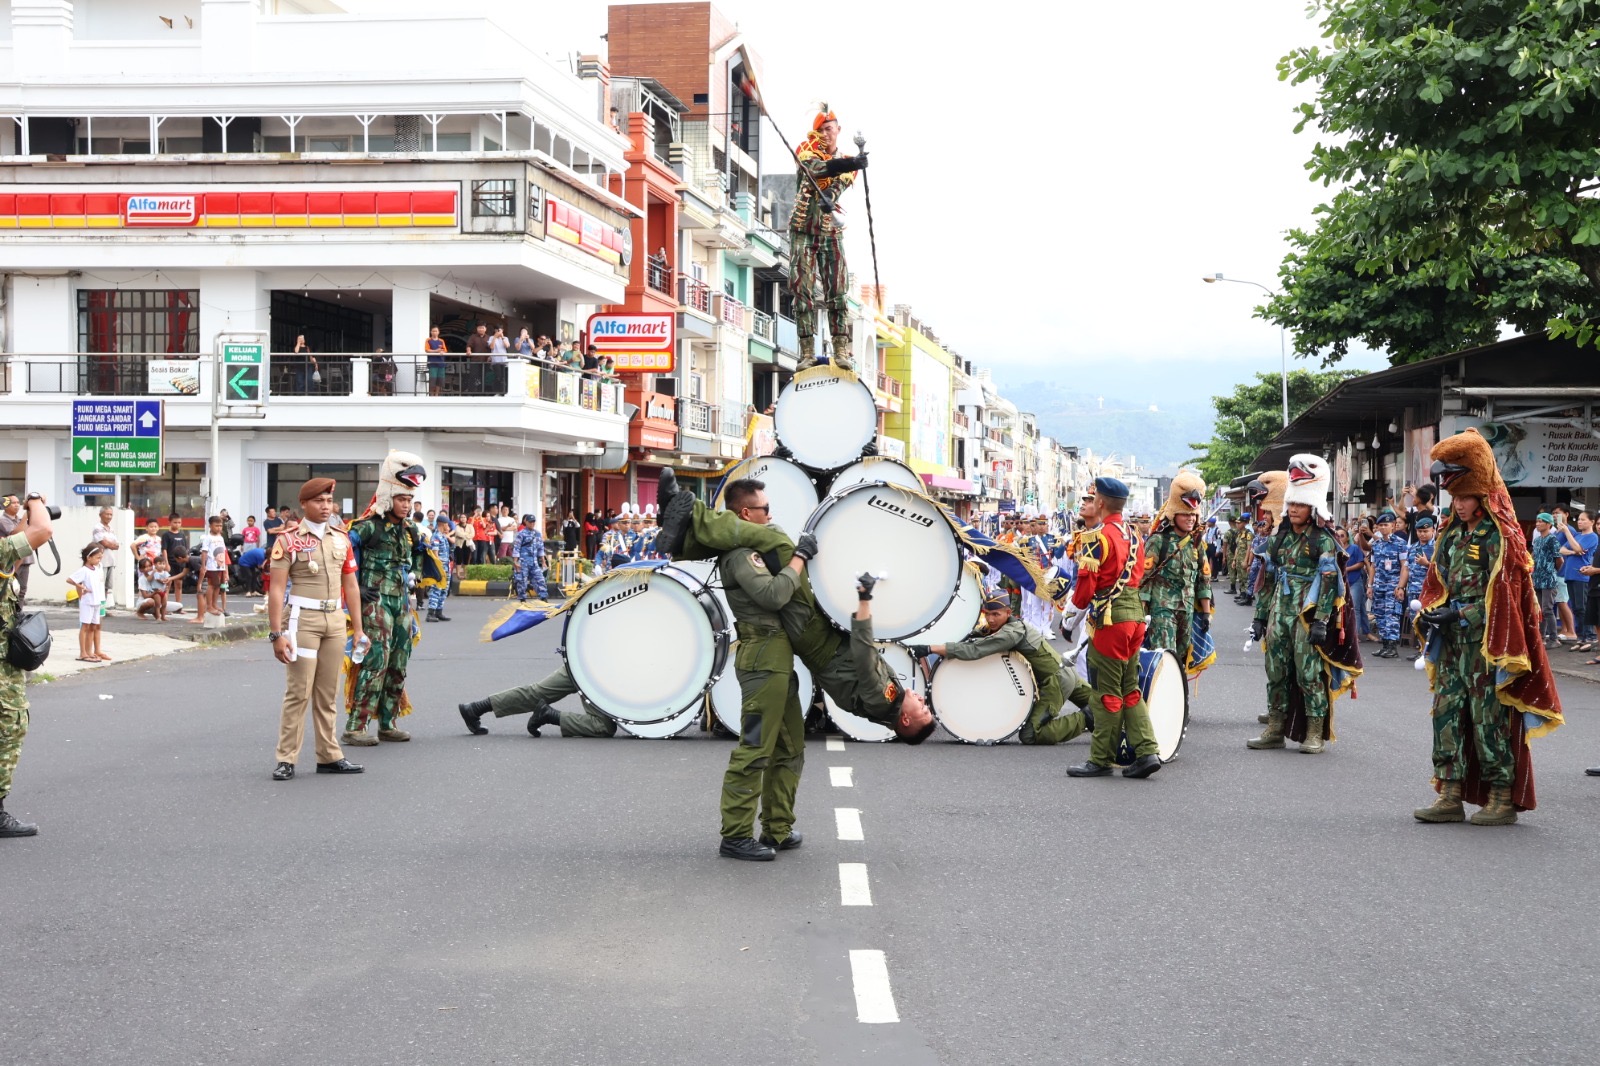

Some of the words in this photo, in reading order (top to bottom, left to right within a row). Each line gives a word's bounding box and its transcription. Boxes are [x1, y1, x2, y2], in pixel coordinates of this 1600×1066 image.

[128, 198, 192, 210] Alfamart
[594, 320, 667, 334] Alfamart
[78, 406, 94, 414] RUKO
[95, 406, 112, 414] MEGA
[112, 406, 133, 414] SMART
[78, 414, 106, 422] JANGKAR
[106, 414, 132, 422] SANDAR
[78, 424, 94, 432] RUKO
[95, 424, 112, 432] MEGA
[112, 424, 133, 432] PROFIT
[104, 442, 129, 450] KELUAR
[1548, 442, 1566, 450] Pork
[1568, 442, 1598, 450] Knuckle
[1548, 454, 1566, 462] Coto
[1568, 454, 1578, 462] Ba
[1566, 464, 1590, 472] Bakar
[1548, 476, 1566, 484] Babi
[1568, 476, 1584, 484] Tore
